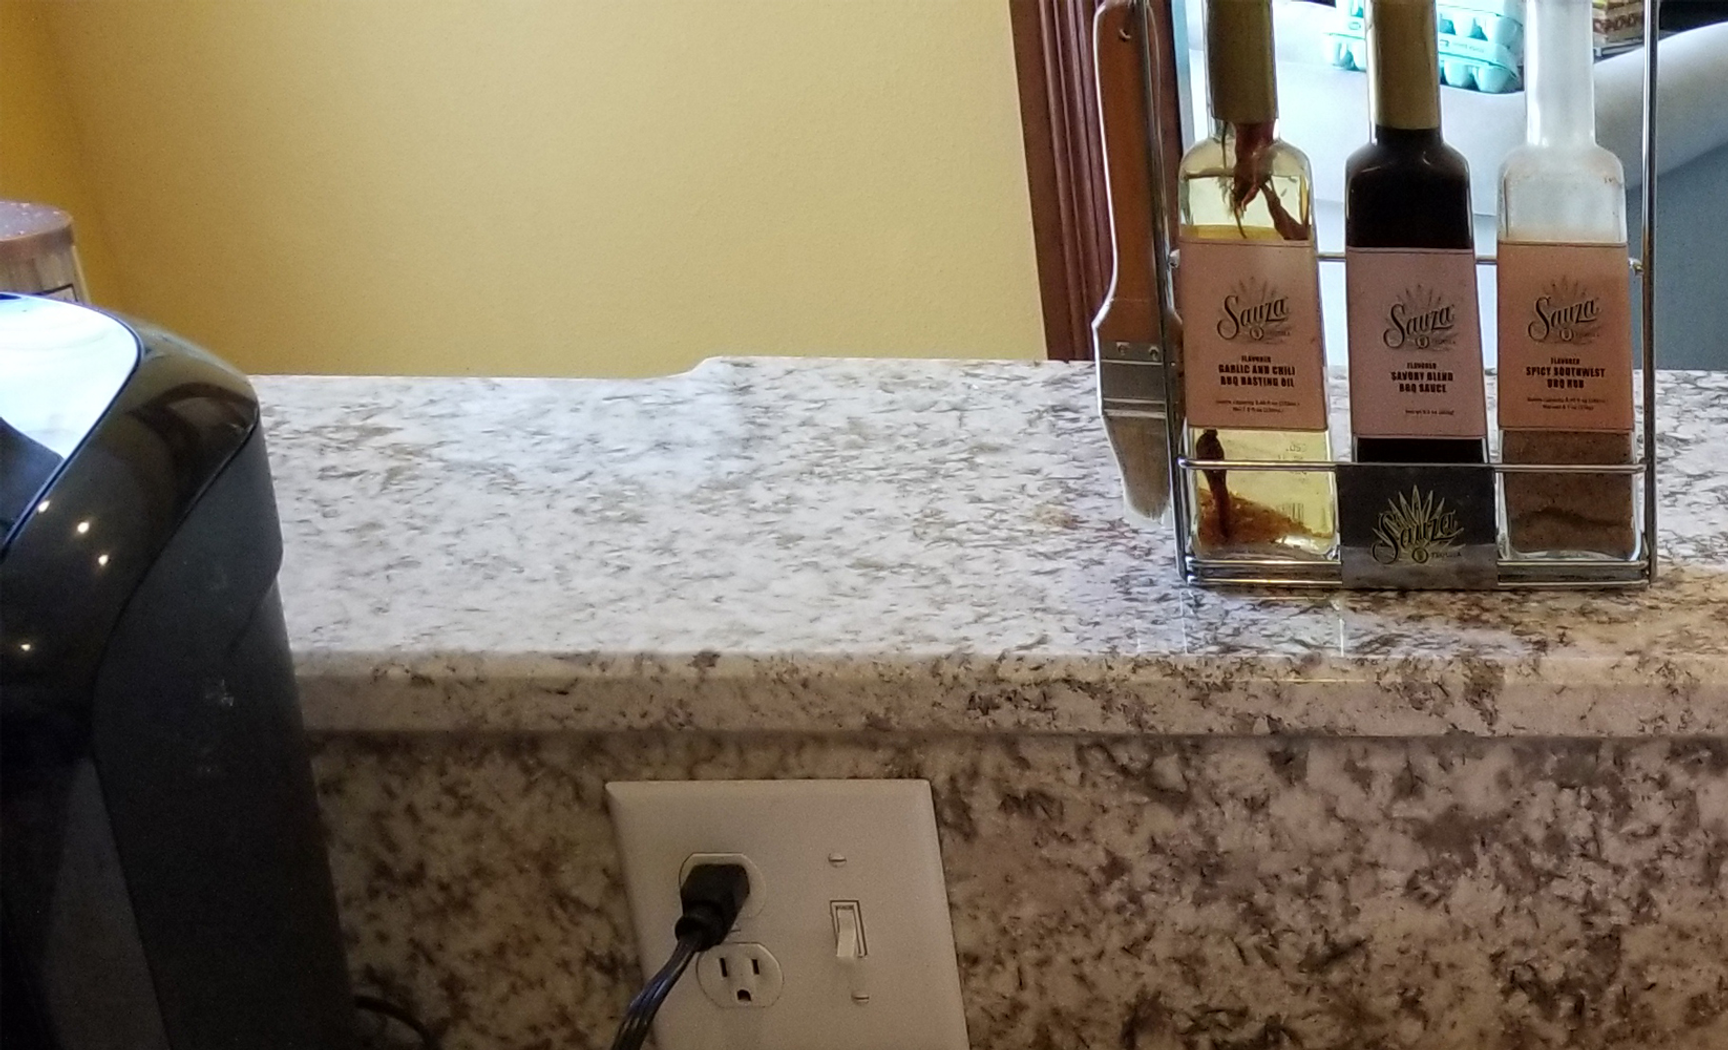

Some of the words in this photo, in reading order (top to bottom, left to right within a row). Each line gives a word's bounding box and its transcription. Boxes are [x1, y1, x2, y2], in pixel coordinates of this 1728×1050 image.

[1217, 295, 1290, 341] Sauza
[1528, 297, 1603, 341] Sauza
[1383, 303, 1455, 349] Sauza
[1218, 364, 1250, 374] GARLIC
[1252, 365, 1270, 375] AND
[1272, 366, 1296, 376] CHILI
[1390, 371, 1424, 381] SAVORY
[1426, 371, 1453, 381] BLEND
[1526, 366, 1551, 376] SPICY
[1553, 367, 1606, 378] SOUTHWEST
[1220, 375, 1239, 387] BBQ
[1240, 376, 1279, 387] BASTING
[1281, 377, 1295, 387] OIL
[1546, 378, 1565, 389] BBQ
[1399, 383, 1417, 393] BBQ
[1418, 383, 1447, 393] SAUCE
[1372, 510, 1457, 564] Sauza
